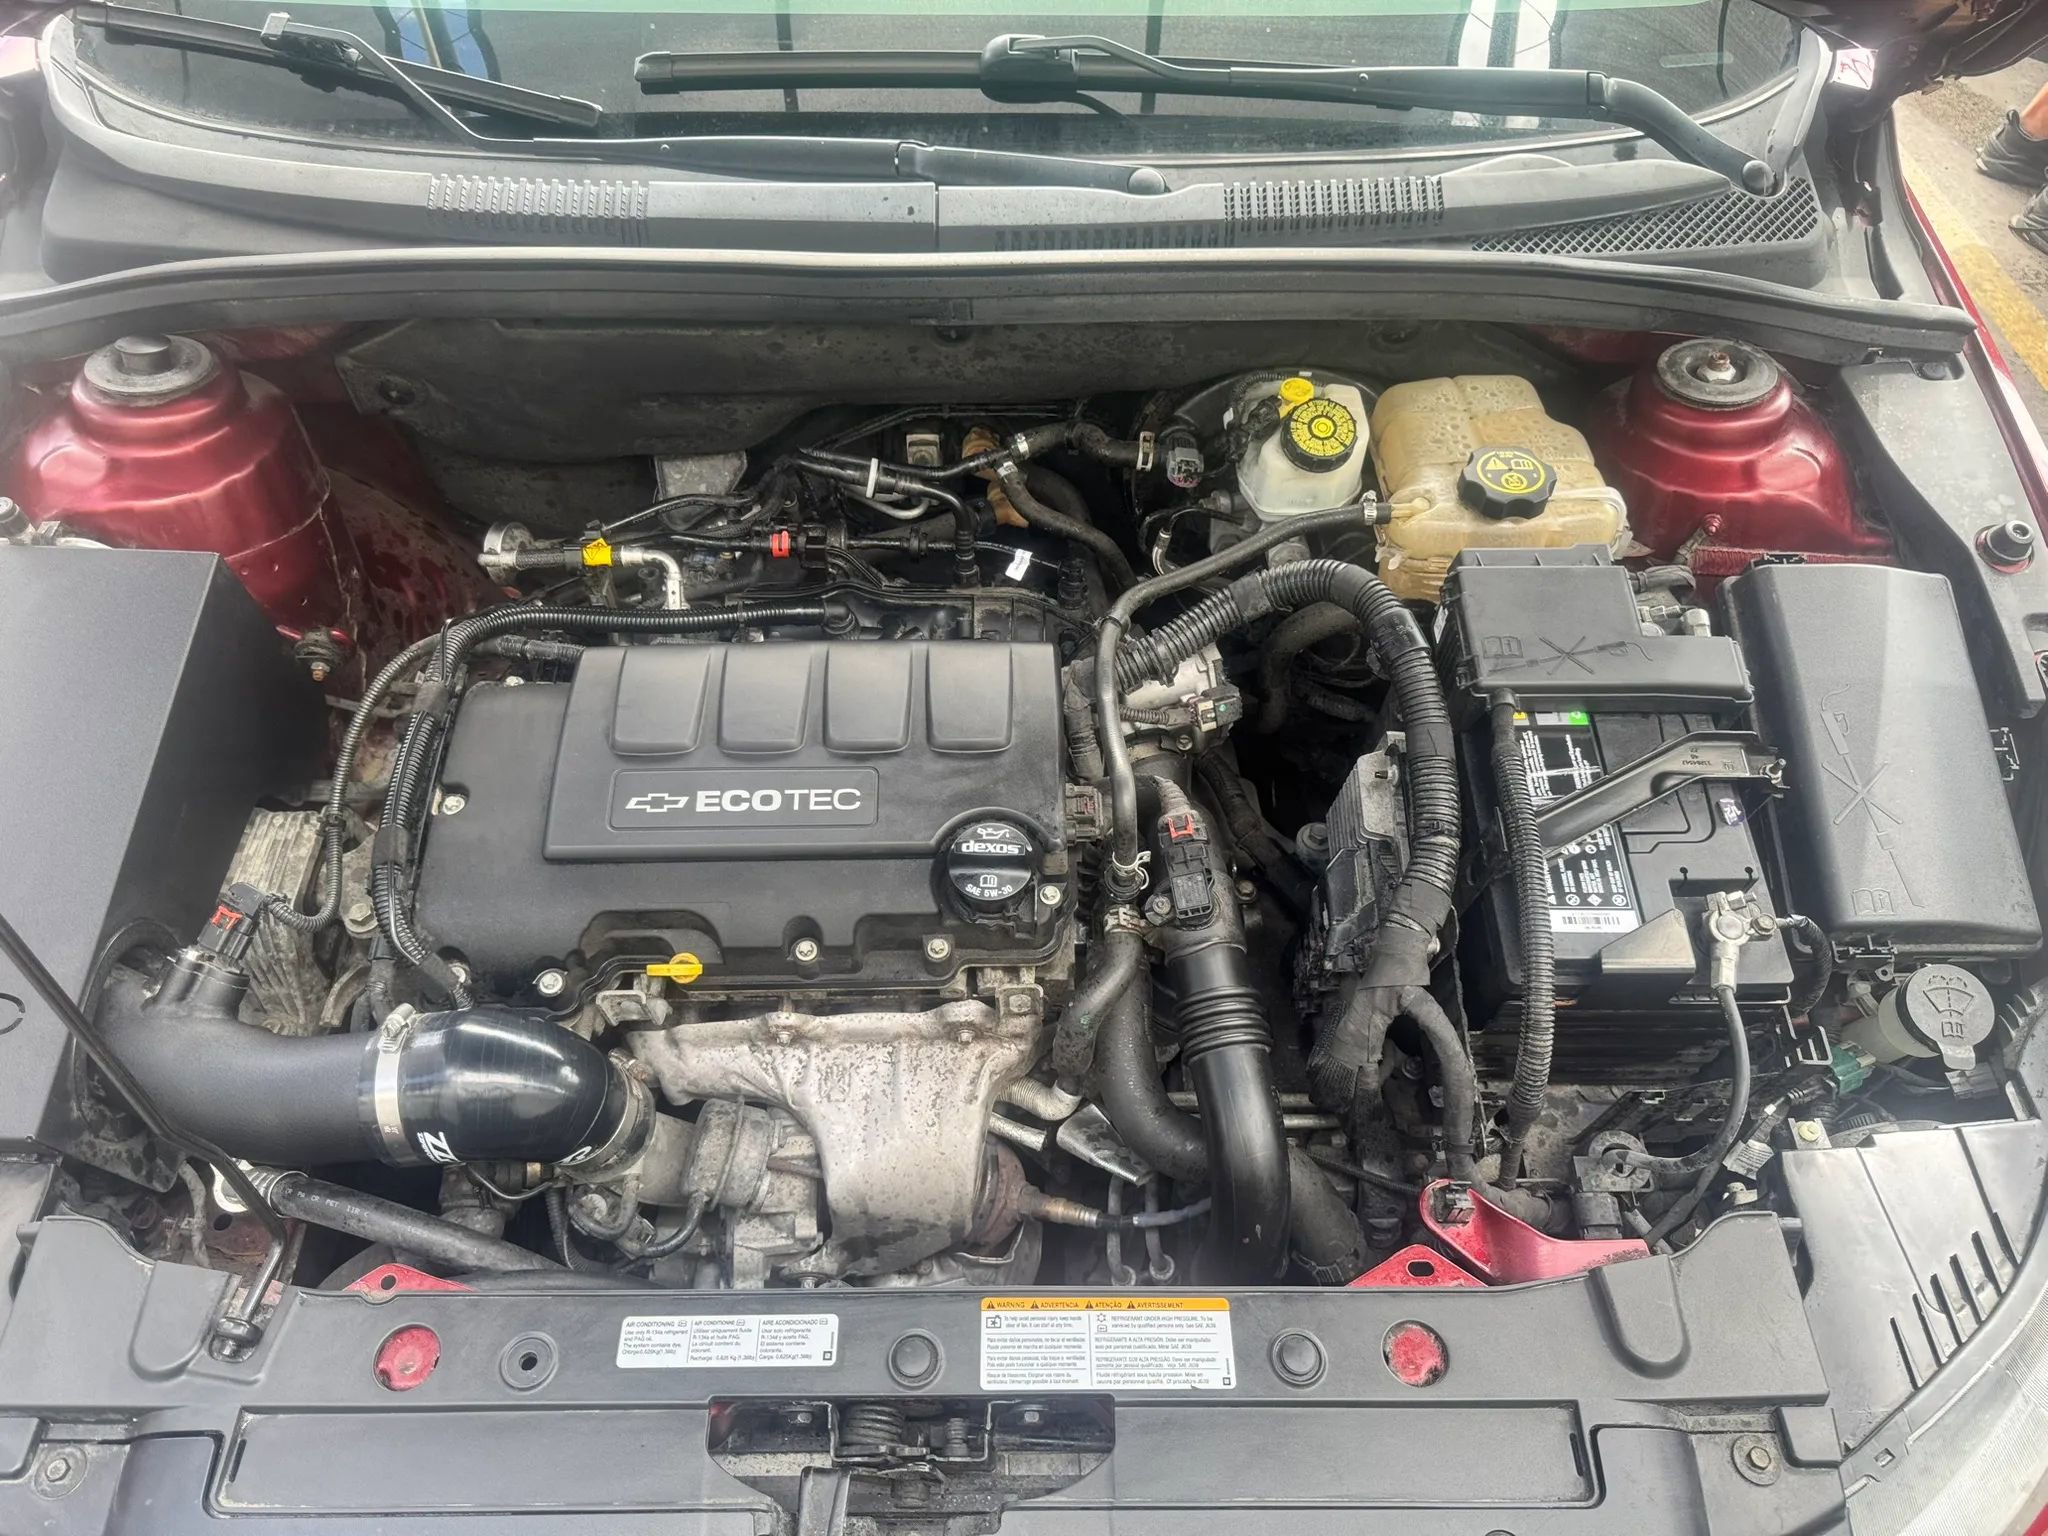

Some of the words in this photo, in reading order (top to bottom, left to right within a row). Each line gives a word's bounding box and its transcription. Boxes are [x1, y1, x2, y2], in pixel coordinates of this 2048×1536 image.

[696, 788, 862, 812] ECOTEC
[962, 840, 1021, 854] dexos
[965, 884, 981, 896] SAE
[984, 884, 1014, 898] 5W-30
